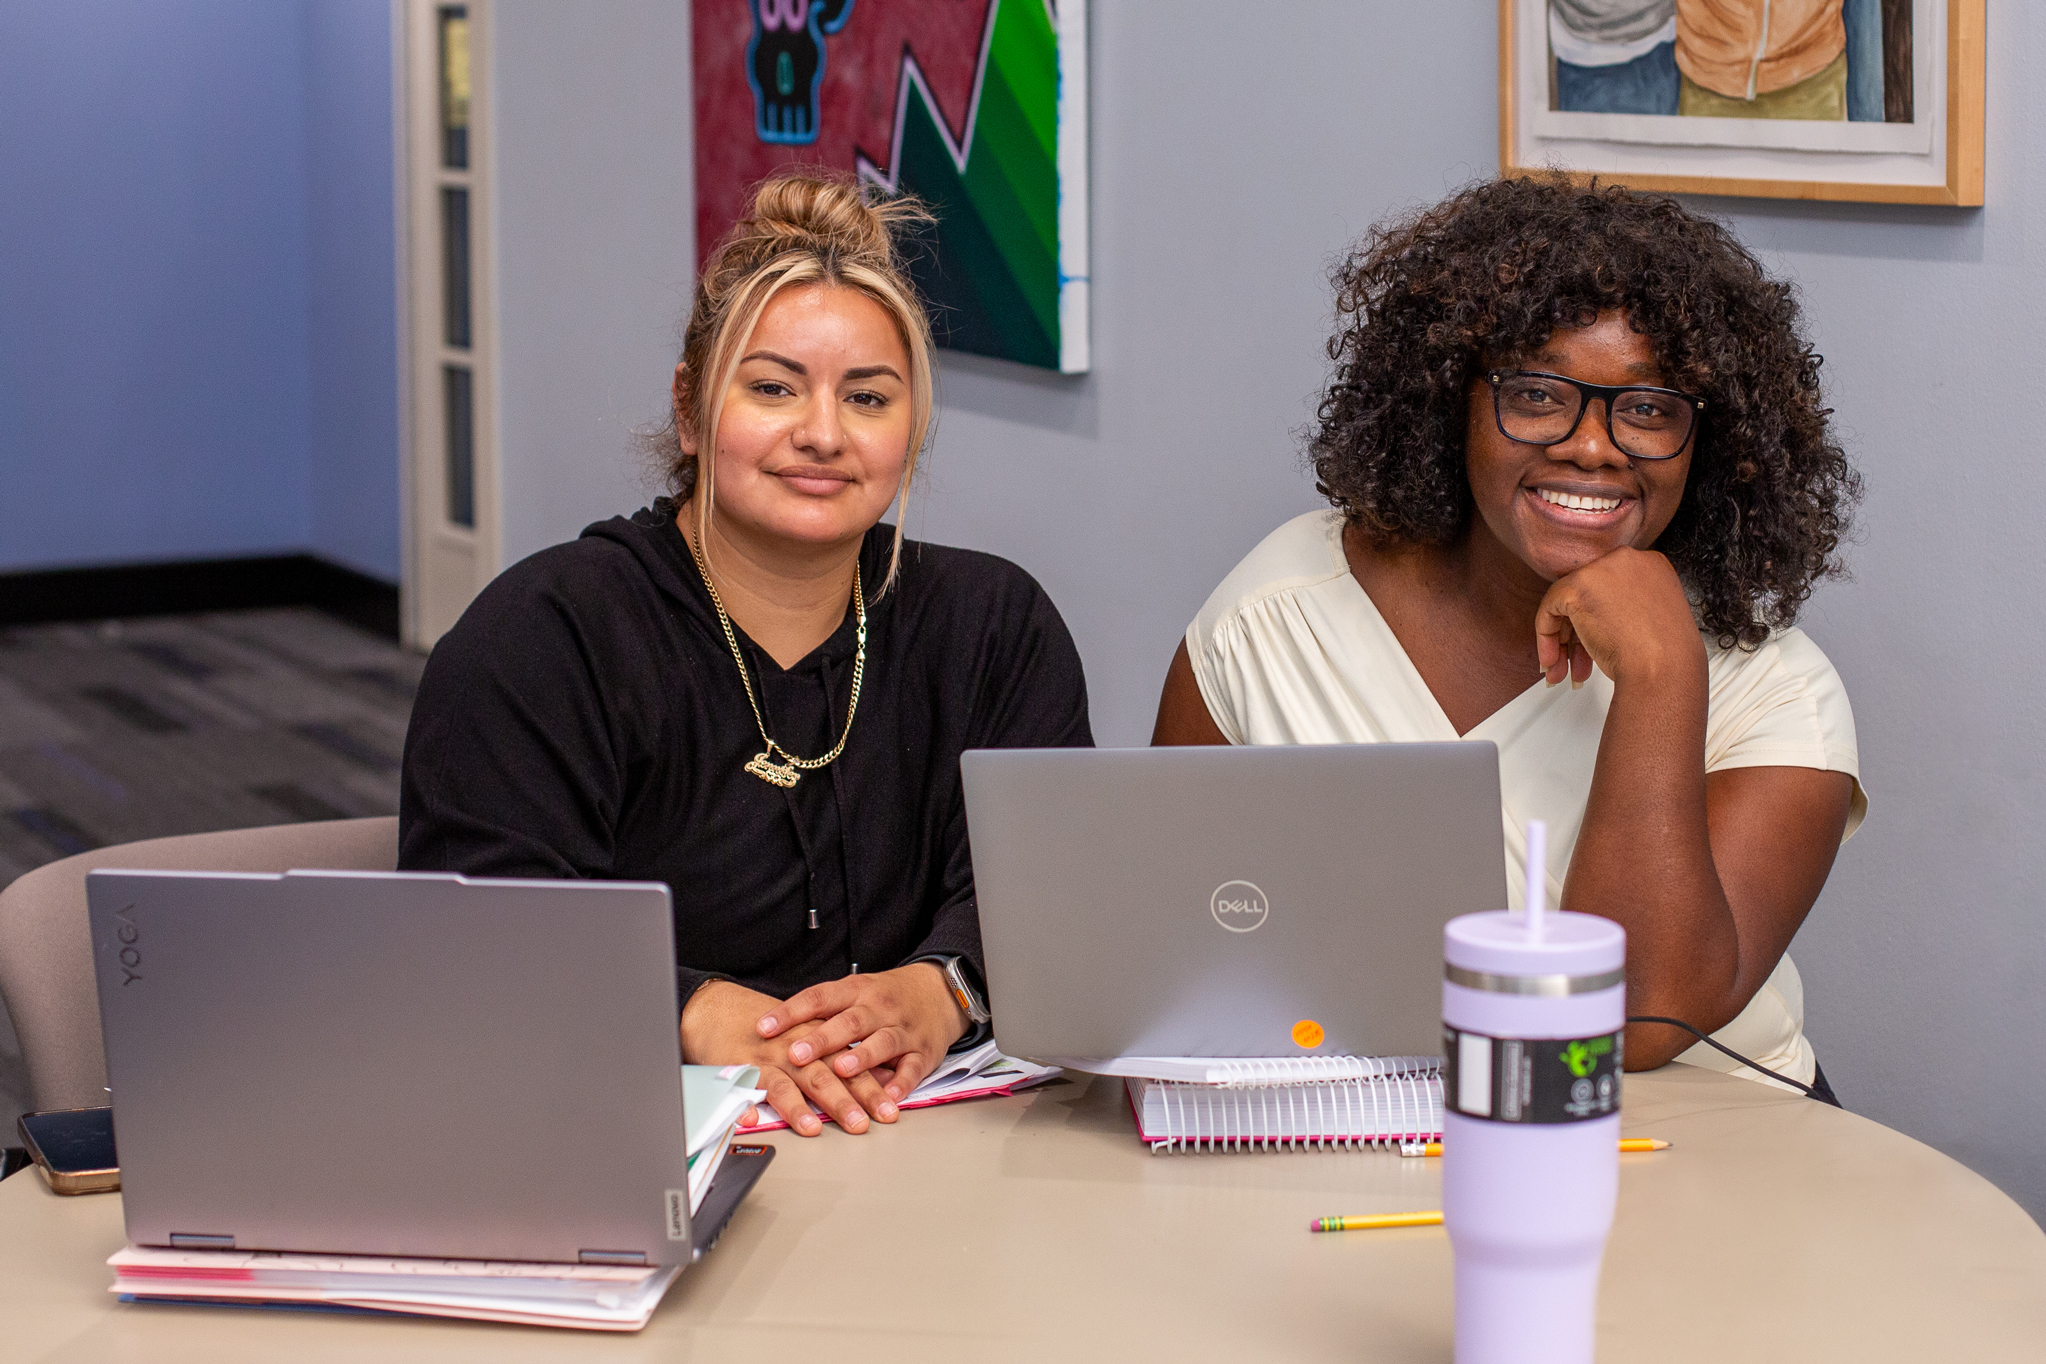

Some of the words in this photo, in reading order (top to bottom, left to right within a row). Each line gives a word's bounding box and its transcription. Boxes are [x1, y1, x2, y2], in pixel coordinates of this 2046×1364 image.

[1217, 899, 1263, 914] DELL
[115, 902, 142, 987] YOGA
[670, 1193, 682, 1237] Lenovo
